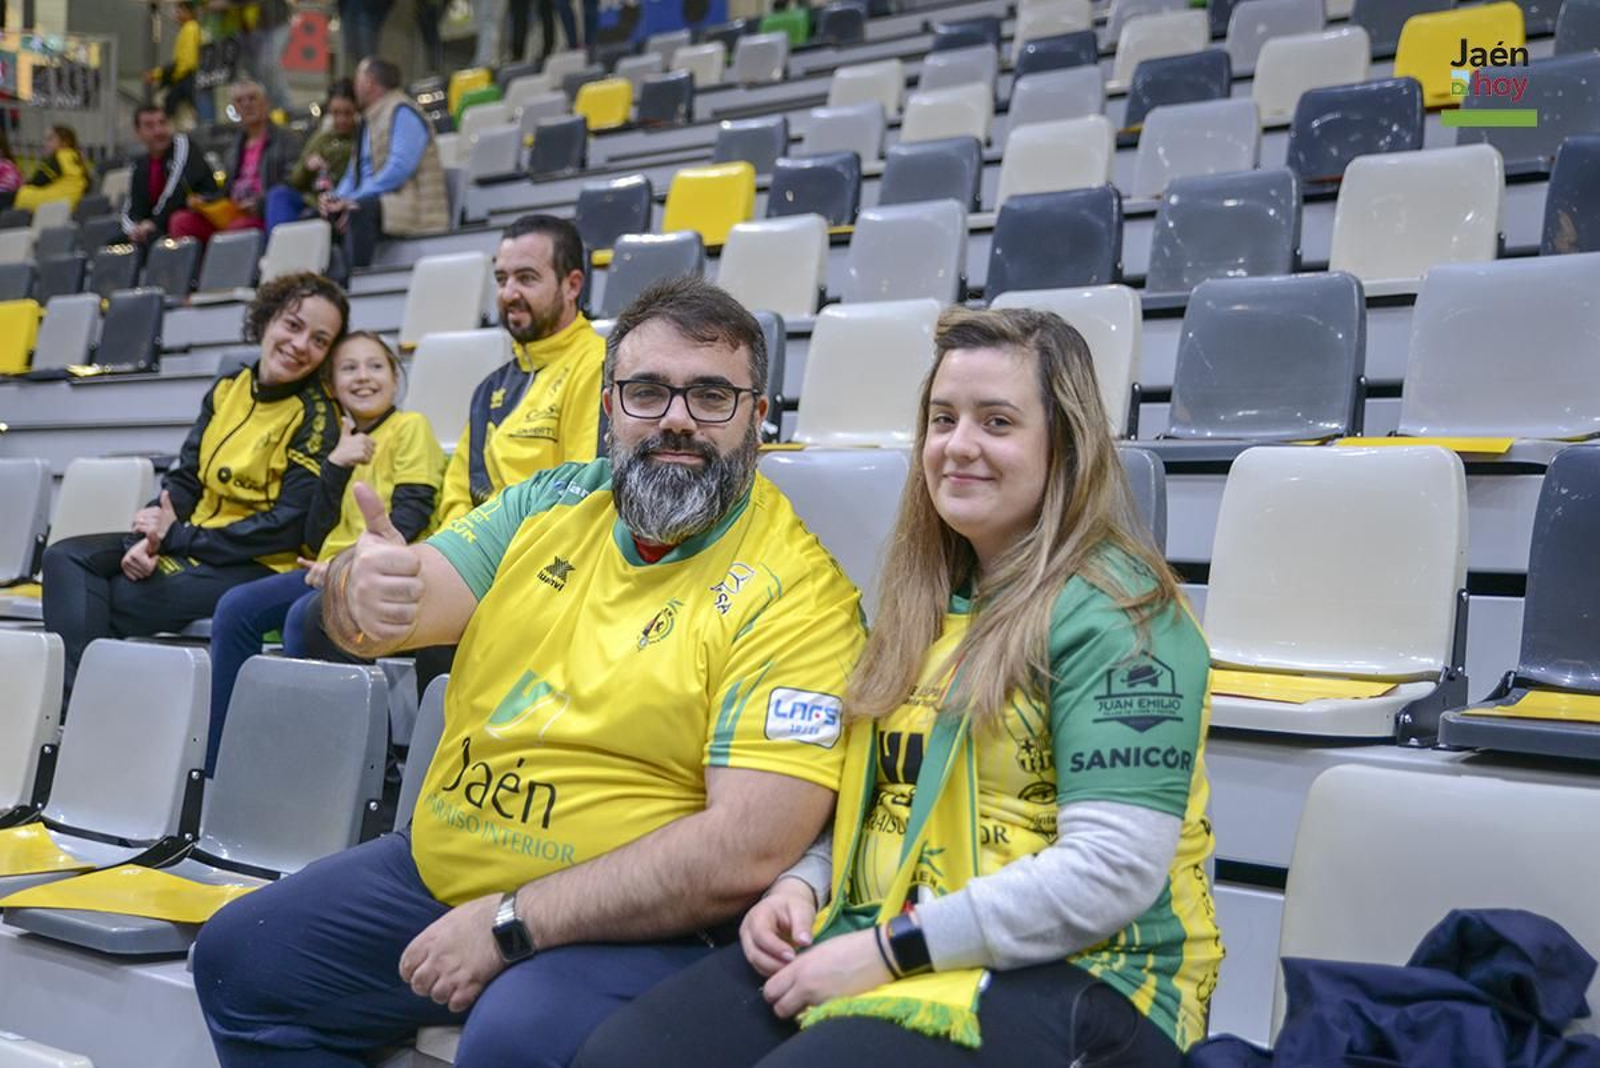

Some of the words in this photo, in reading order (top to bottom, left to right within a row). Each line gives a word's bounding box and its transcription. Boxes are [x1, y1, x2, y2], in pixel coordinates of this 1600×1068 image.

[1098, 700, 1134, 713] JUAN
[1137, 698, 1182, 711] EMILIO
[442, 736, 557, 830] Jaén
[482, 820, 576, 865] INTERIOR
